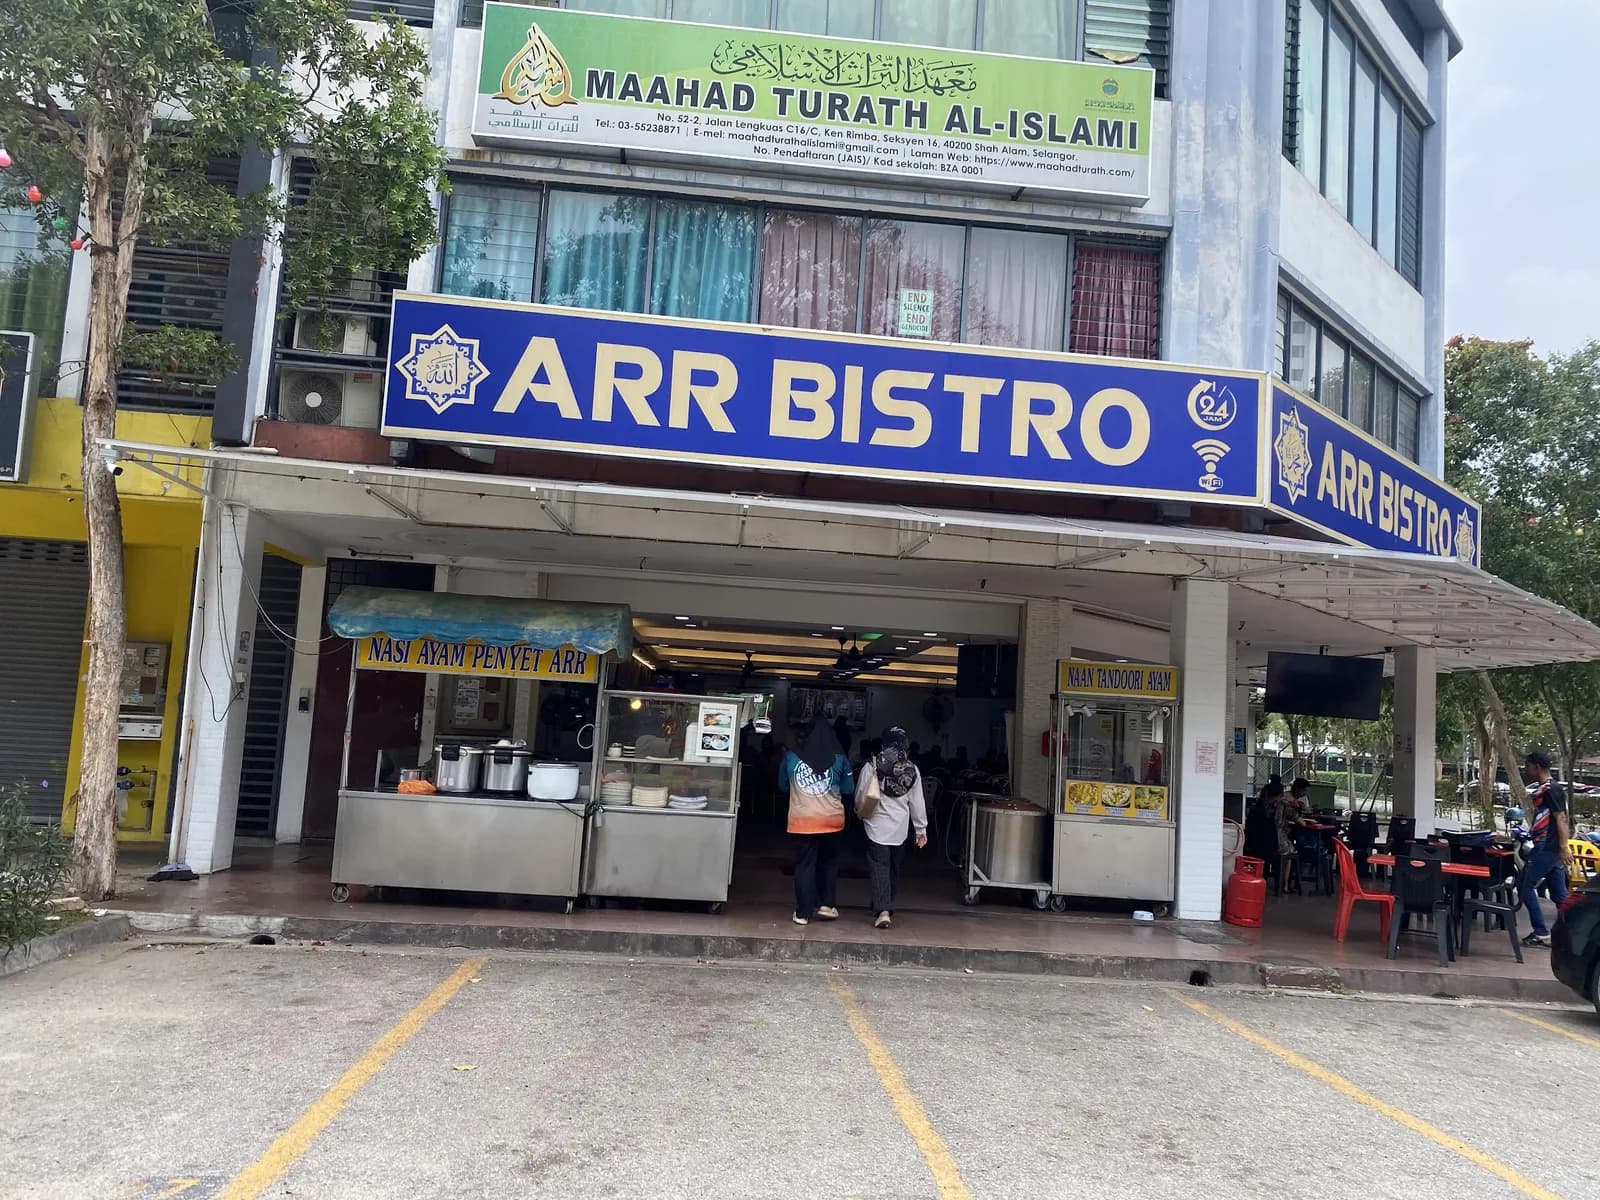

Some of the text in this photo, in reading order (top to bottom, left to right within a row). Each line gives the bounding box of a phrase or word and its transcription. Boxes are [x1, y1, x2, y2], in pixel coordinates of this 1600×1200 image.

[586, 69, 1138, 150] MAAHAD TURATH AL-ISLAMI
[595, 118, 1136, 179] Tel.: 03-55238871 E-mel: maahadturathalislami@gmail.com Laman Web: https://www.maahadturath.com/
[657, 113, 1078, 162] No. 52-2, Jalan Lengkuas C16/C, Ken Rimba, Seksyen 16, 40200 Shah Alam, Selangor.
[753, 145, 984, 176] No. Pendaftaran (JAIS)/ Kod sekolah: BZA 0001
[903, 303, 930, 312] SILENCE
[908, 292, 927, 303] END
[901, 324, 928, 332] GENOCIDE
[906, 313, 925, 324] END
[492, 335, 1151, 467] ARR BISTRO
[1199, 394, 1230, 419] 24
[1202, 414, 1223, 423] JAM
[1316, 440, 1374, 525] ARR
[1378, 471, 1452, 557] BISTRO
[367, 636, 588, 675] NASI AYAM PENYET ARR
[1067, 667, 1172, 692] NAAN TANDOORI AYAM
